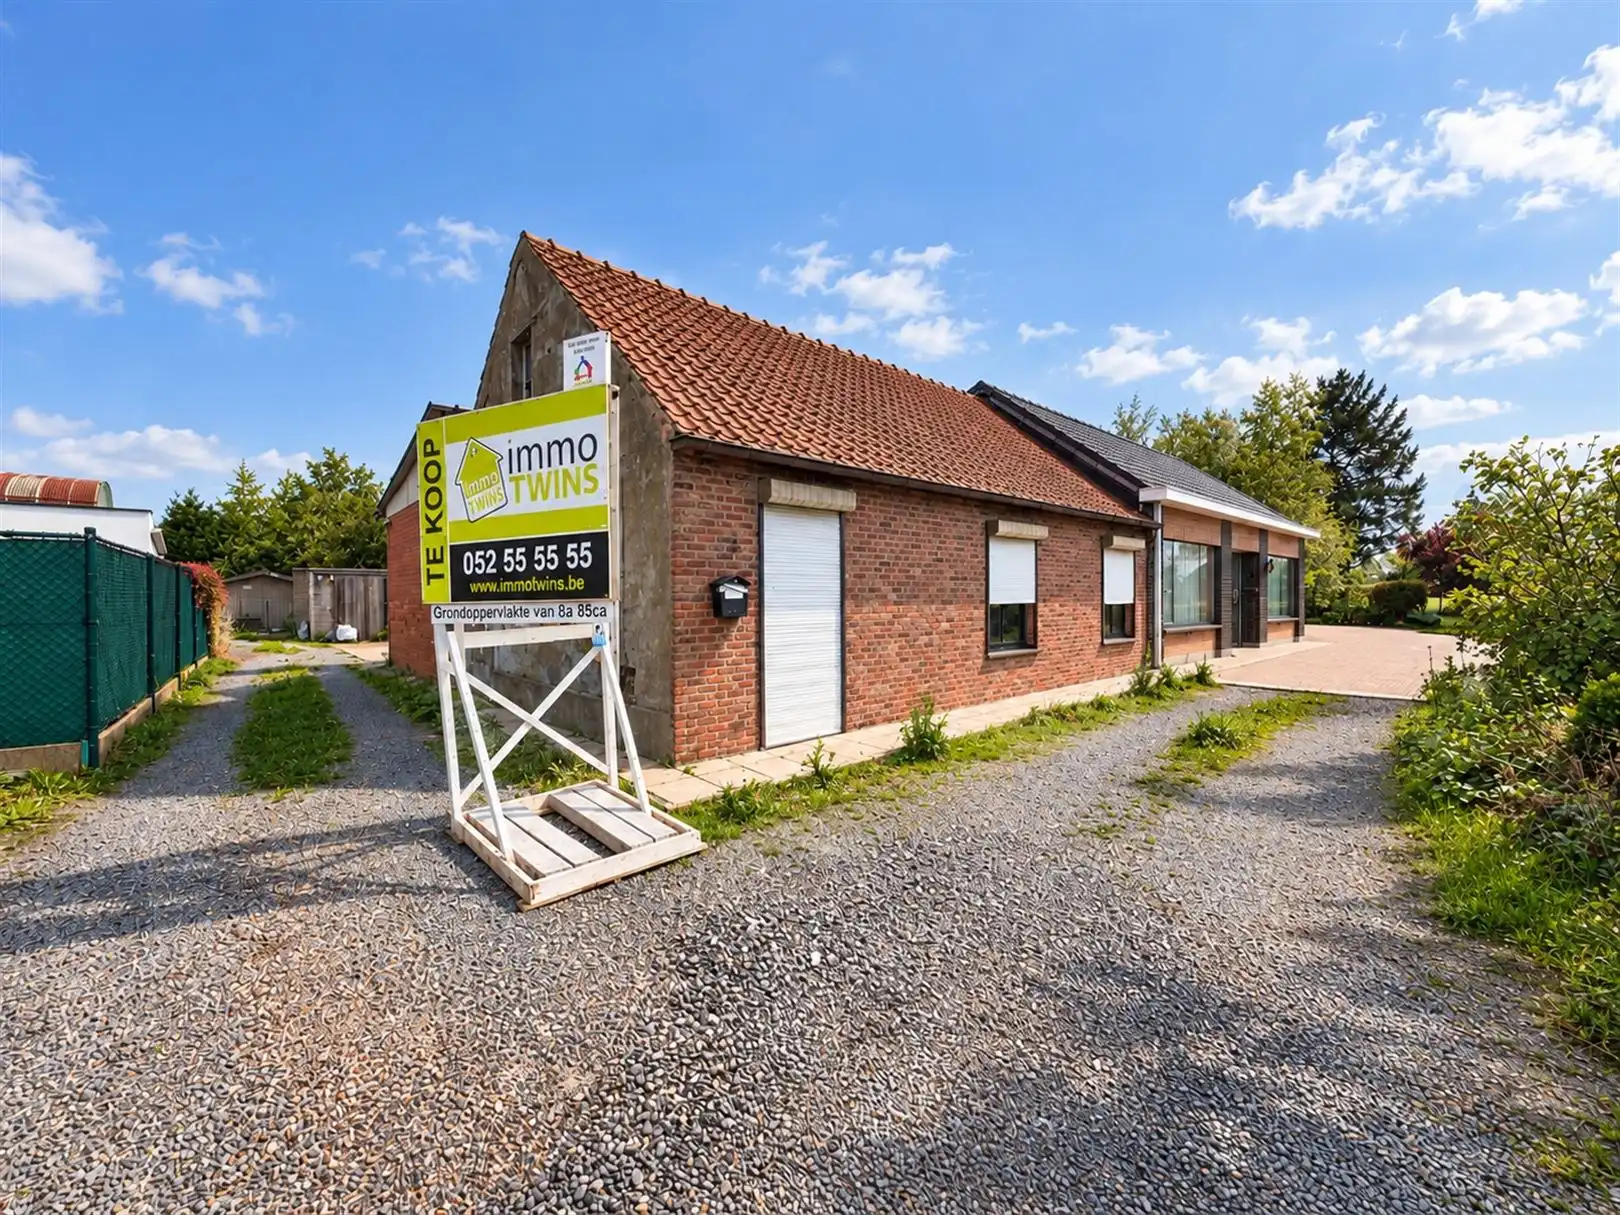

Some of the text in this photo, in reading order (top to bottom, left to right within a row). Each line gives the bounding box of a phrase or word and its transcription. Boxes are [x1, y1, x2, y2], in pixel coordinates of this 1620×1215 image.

[508, 433, 598, 474] immo
[509, 463, 599, 504] TWINS
[423, 438, 445, 586] TE KOOP
[463, 541, 593, 575] 052 55 55 55
[469, 575, 585, 593] www.immotwins.be
[433, 603, 607, 622] Grondoppervlakte van 8a 85ca
